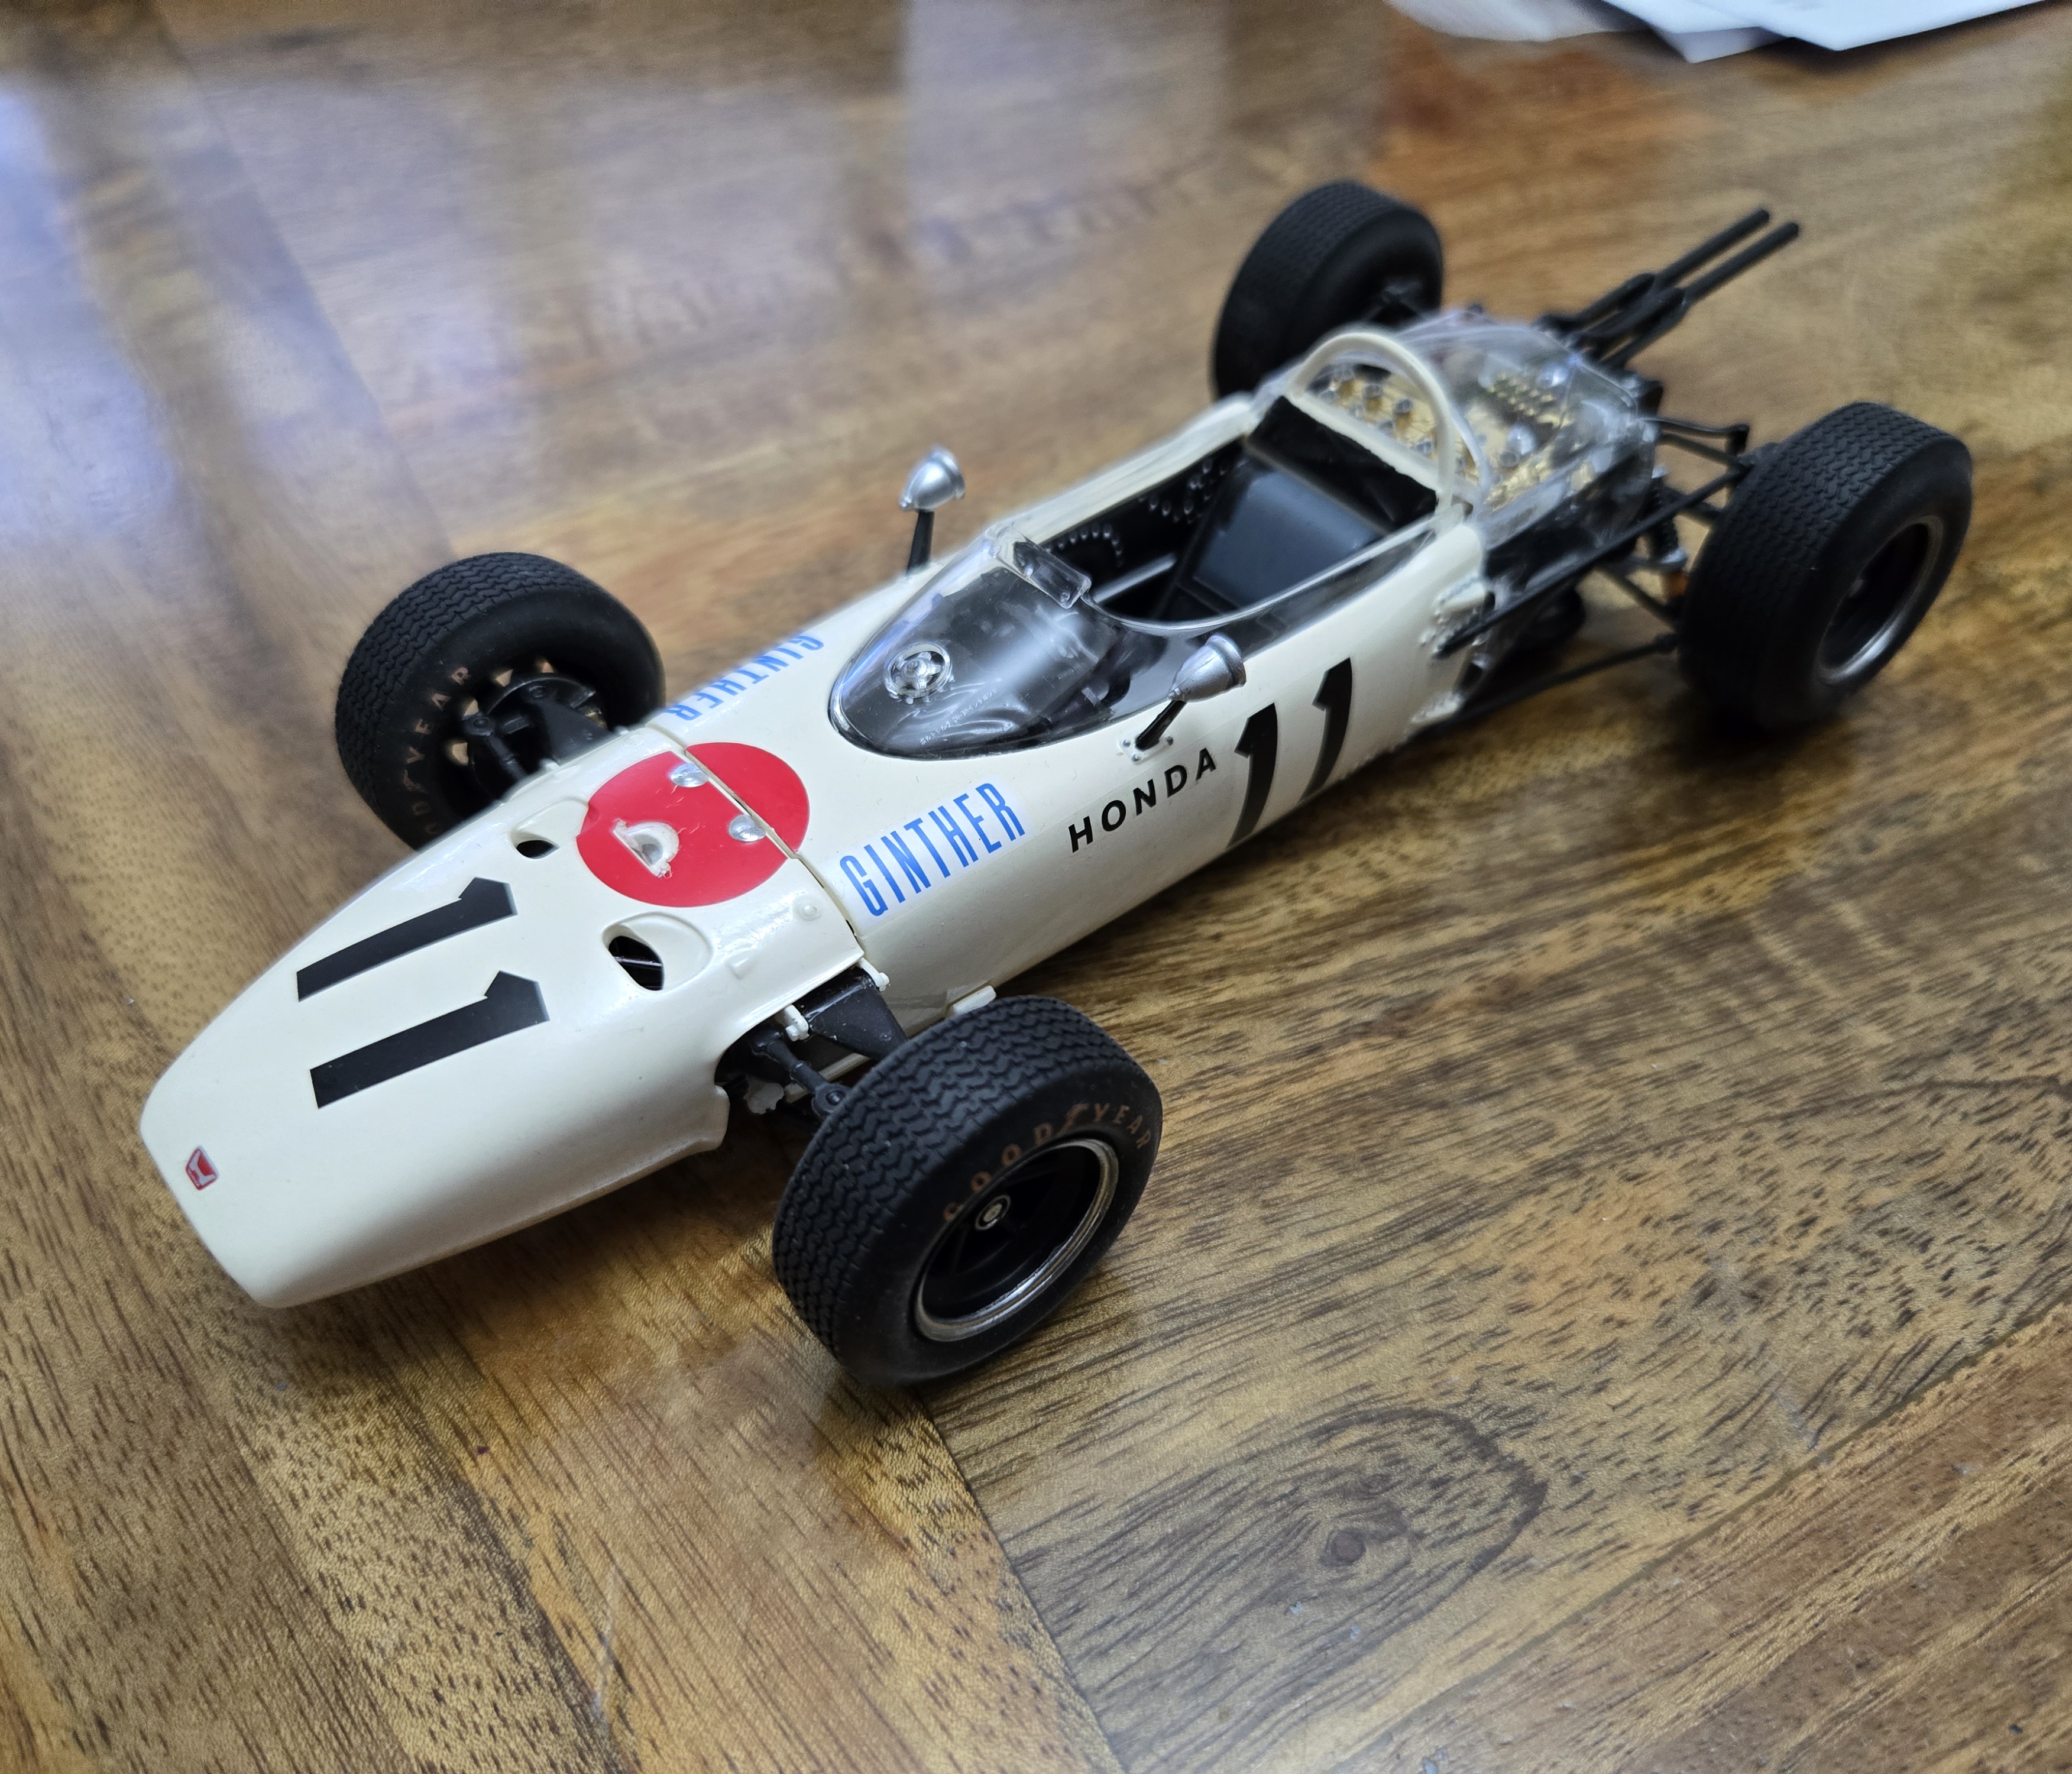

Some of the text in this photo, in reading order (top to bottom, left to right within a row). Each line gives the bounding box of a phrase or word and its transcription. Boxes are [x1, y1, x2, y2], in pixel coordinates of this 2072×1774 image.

[666, 635, 824, 721] GINTHER
[1067, 748, 1217, 853] HONDA
[1225, 657, 1353, 849] 11
[838, 782, 1026, 917] GINTHER
[296, 876, 550, 1109] 11
